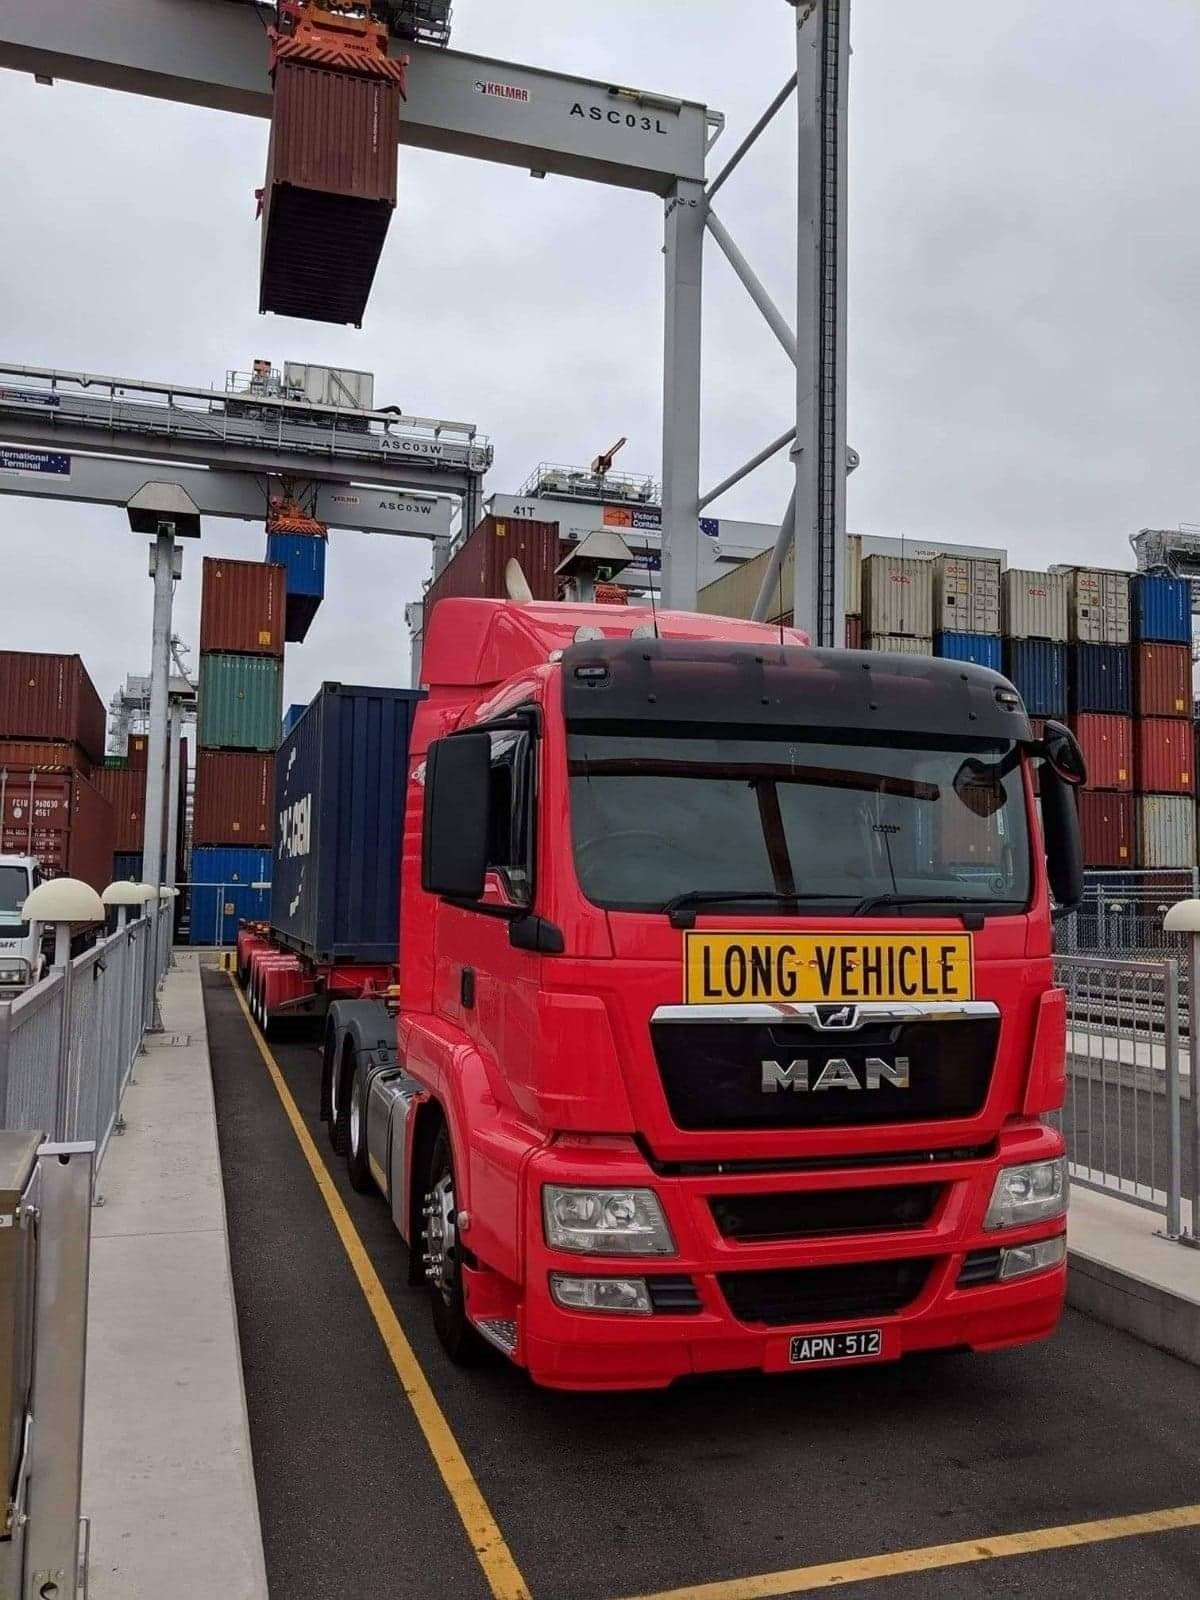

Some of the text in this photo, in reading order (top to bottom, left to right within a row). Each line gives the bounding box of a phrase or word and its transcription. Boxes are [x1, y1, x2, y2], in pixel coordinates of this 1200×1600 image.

[486, 82, 529, 101] KALMAR
[569, 103, 668, 135] ASC03L
[381, 440, 442, 454] ASC03W
[3, 458, 41, 471] Terminal
[379, 501, 432, 515] ASC03W
[513, 505, 536, 518] 41T
[632, 511, 660, 522] Victoria
[703, 944, 959, 997] LONG VEHICLE
[761, 1056, 910, 1093] MAN
